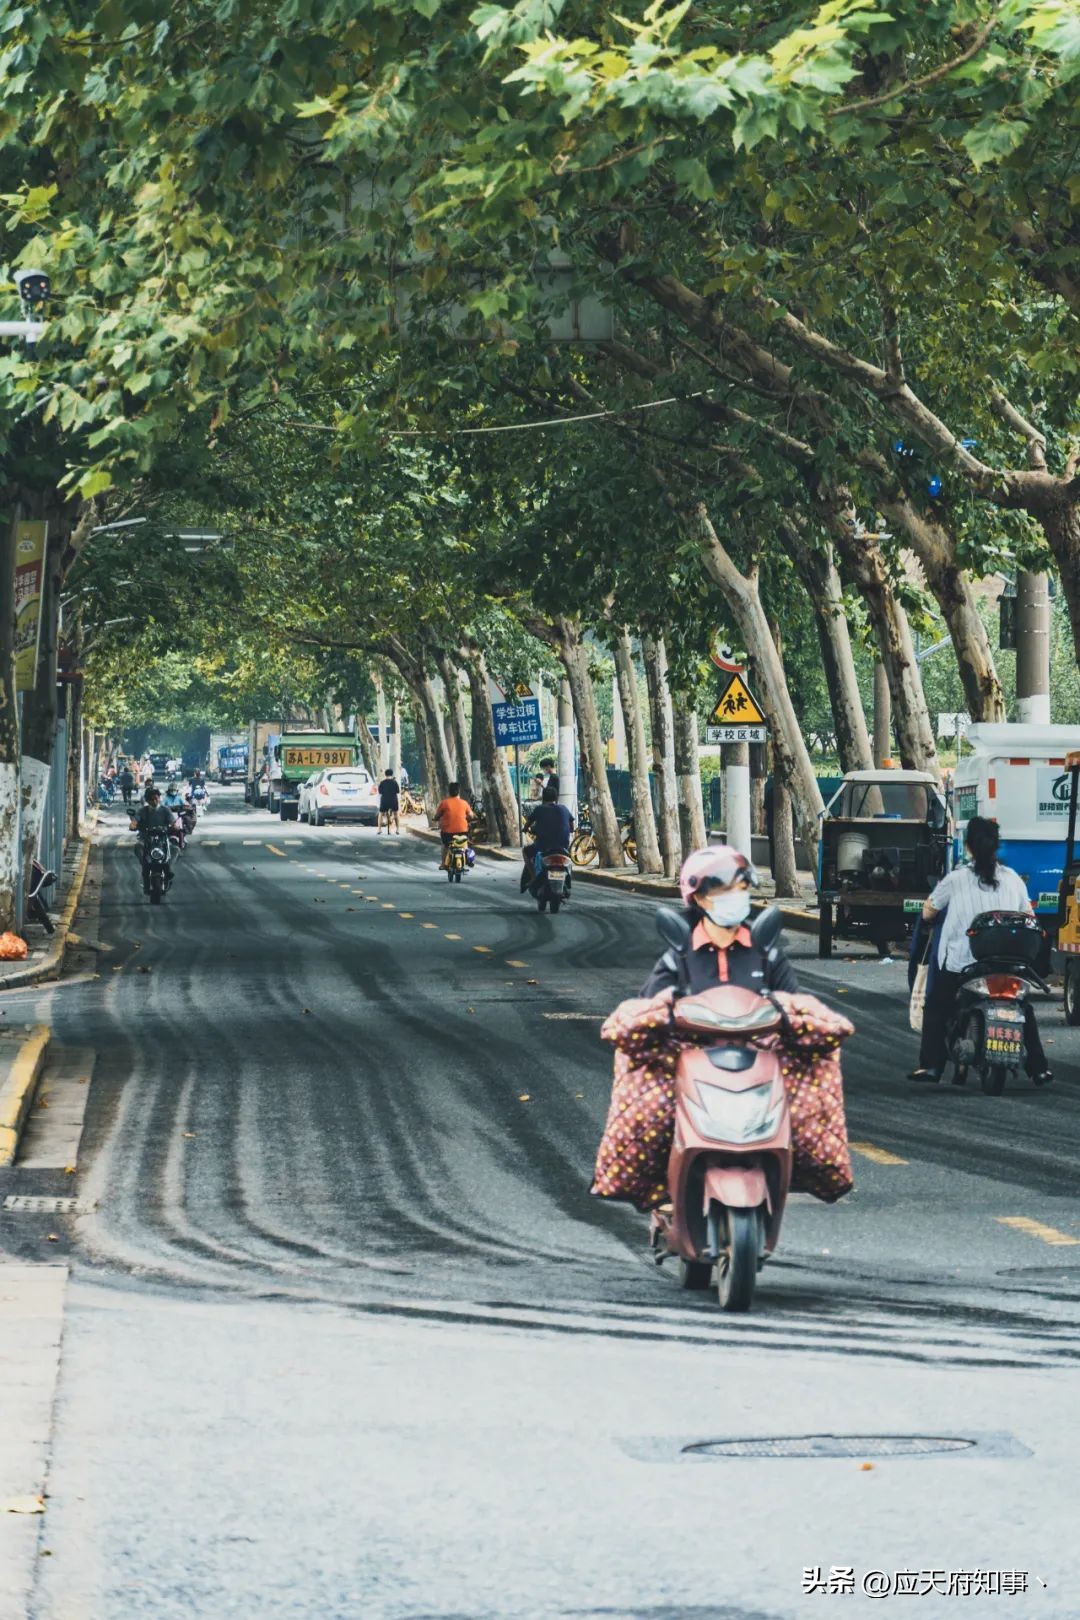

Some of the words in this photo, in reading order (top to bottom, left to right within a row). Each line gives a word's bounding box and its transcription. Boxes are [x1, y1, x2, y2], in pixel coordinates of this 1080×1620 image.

[496, 703, 536, 720] 学生过街
[498, 720, 538, 736] 停车让行
[712, 729, 760, 740] 学校区域
